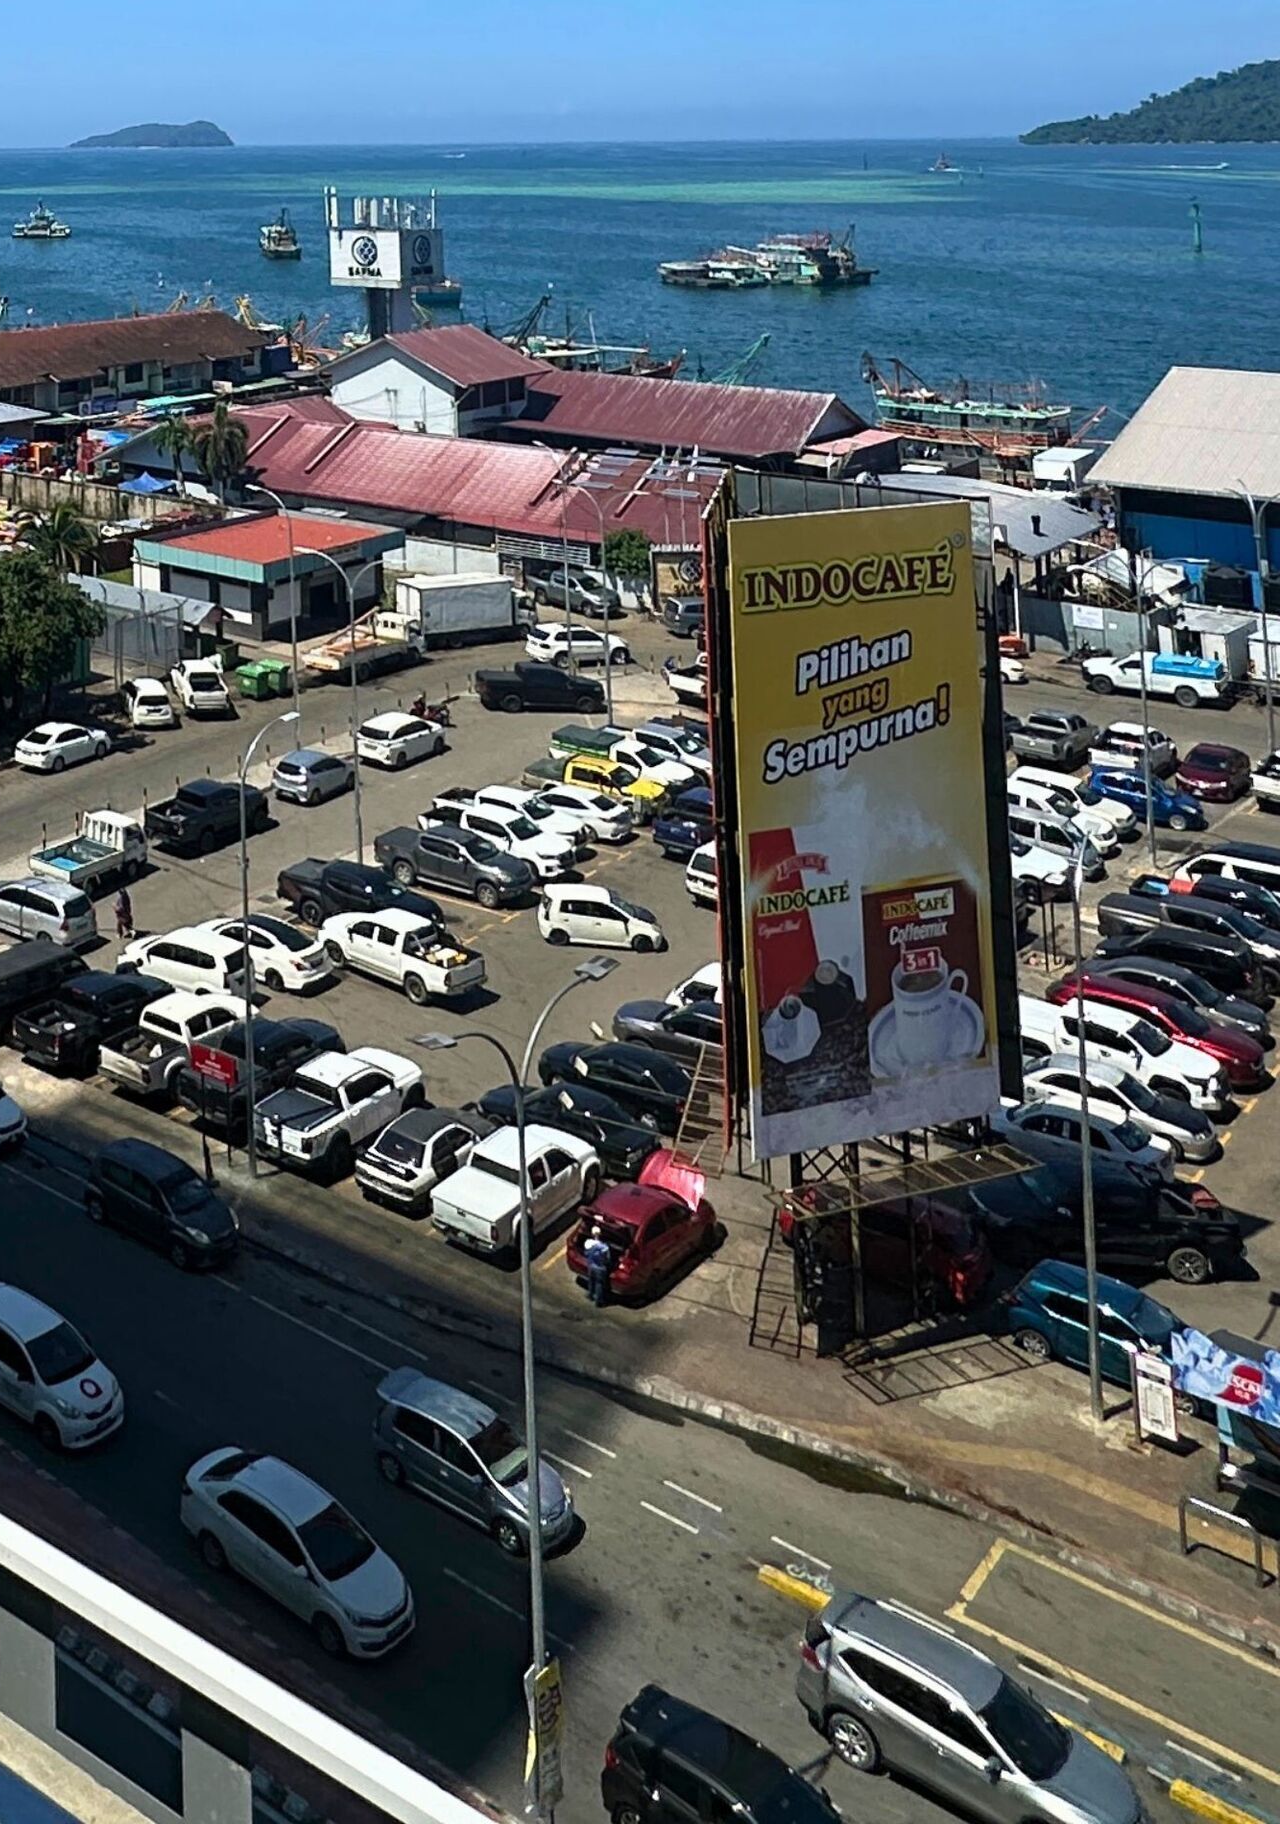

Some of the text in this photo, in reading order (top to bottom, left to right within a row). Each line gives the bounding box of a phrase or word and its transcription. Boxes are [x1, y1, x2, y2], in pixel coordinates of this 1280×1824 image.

[742, 542, 953, 610] INDOCAFÉ
[796, 631, 911, 694] Pilihan
[823, 679, 888, 728] yang
[764, 683, 950, 783] Sempurna!
[759, 880, 850, 914] INDOCAFÉ
[883, 893, 948, 919] INDOCAFÉ
[890, 919, 948, 945] Coffeemix
